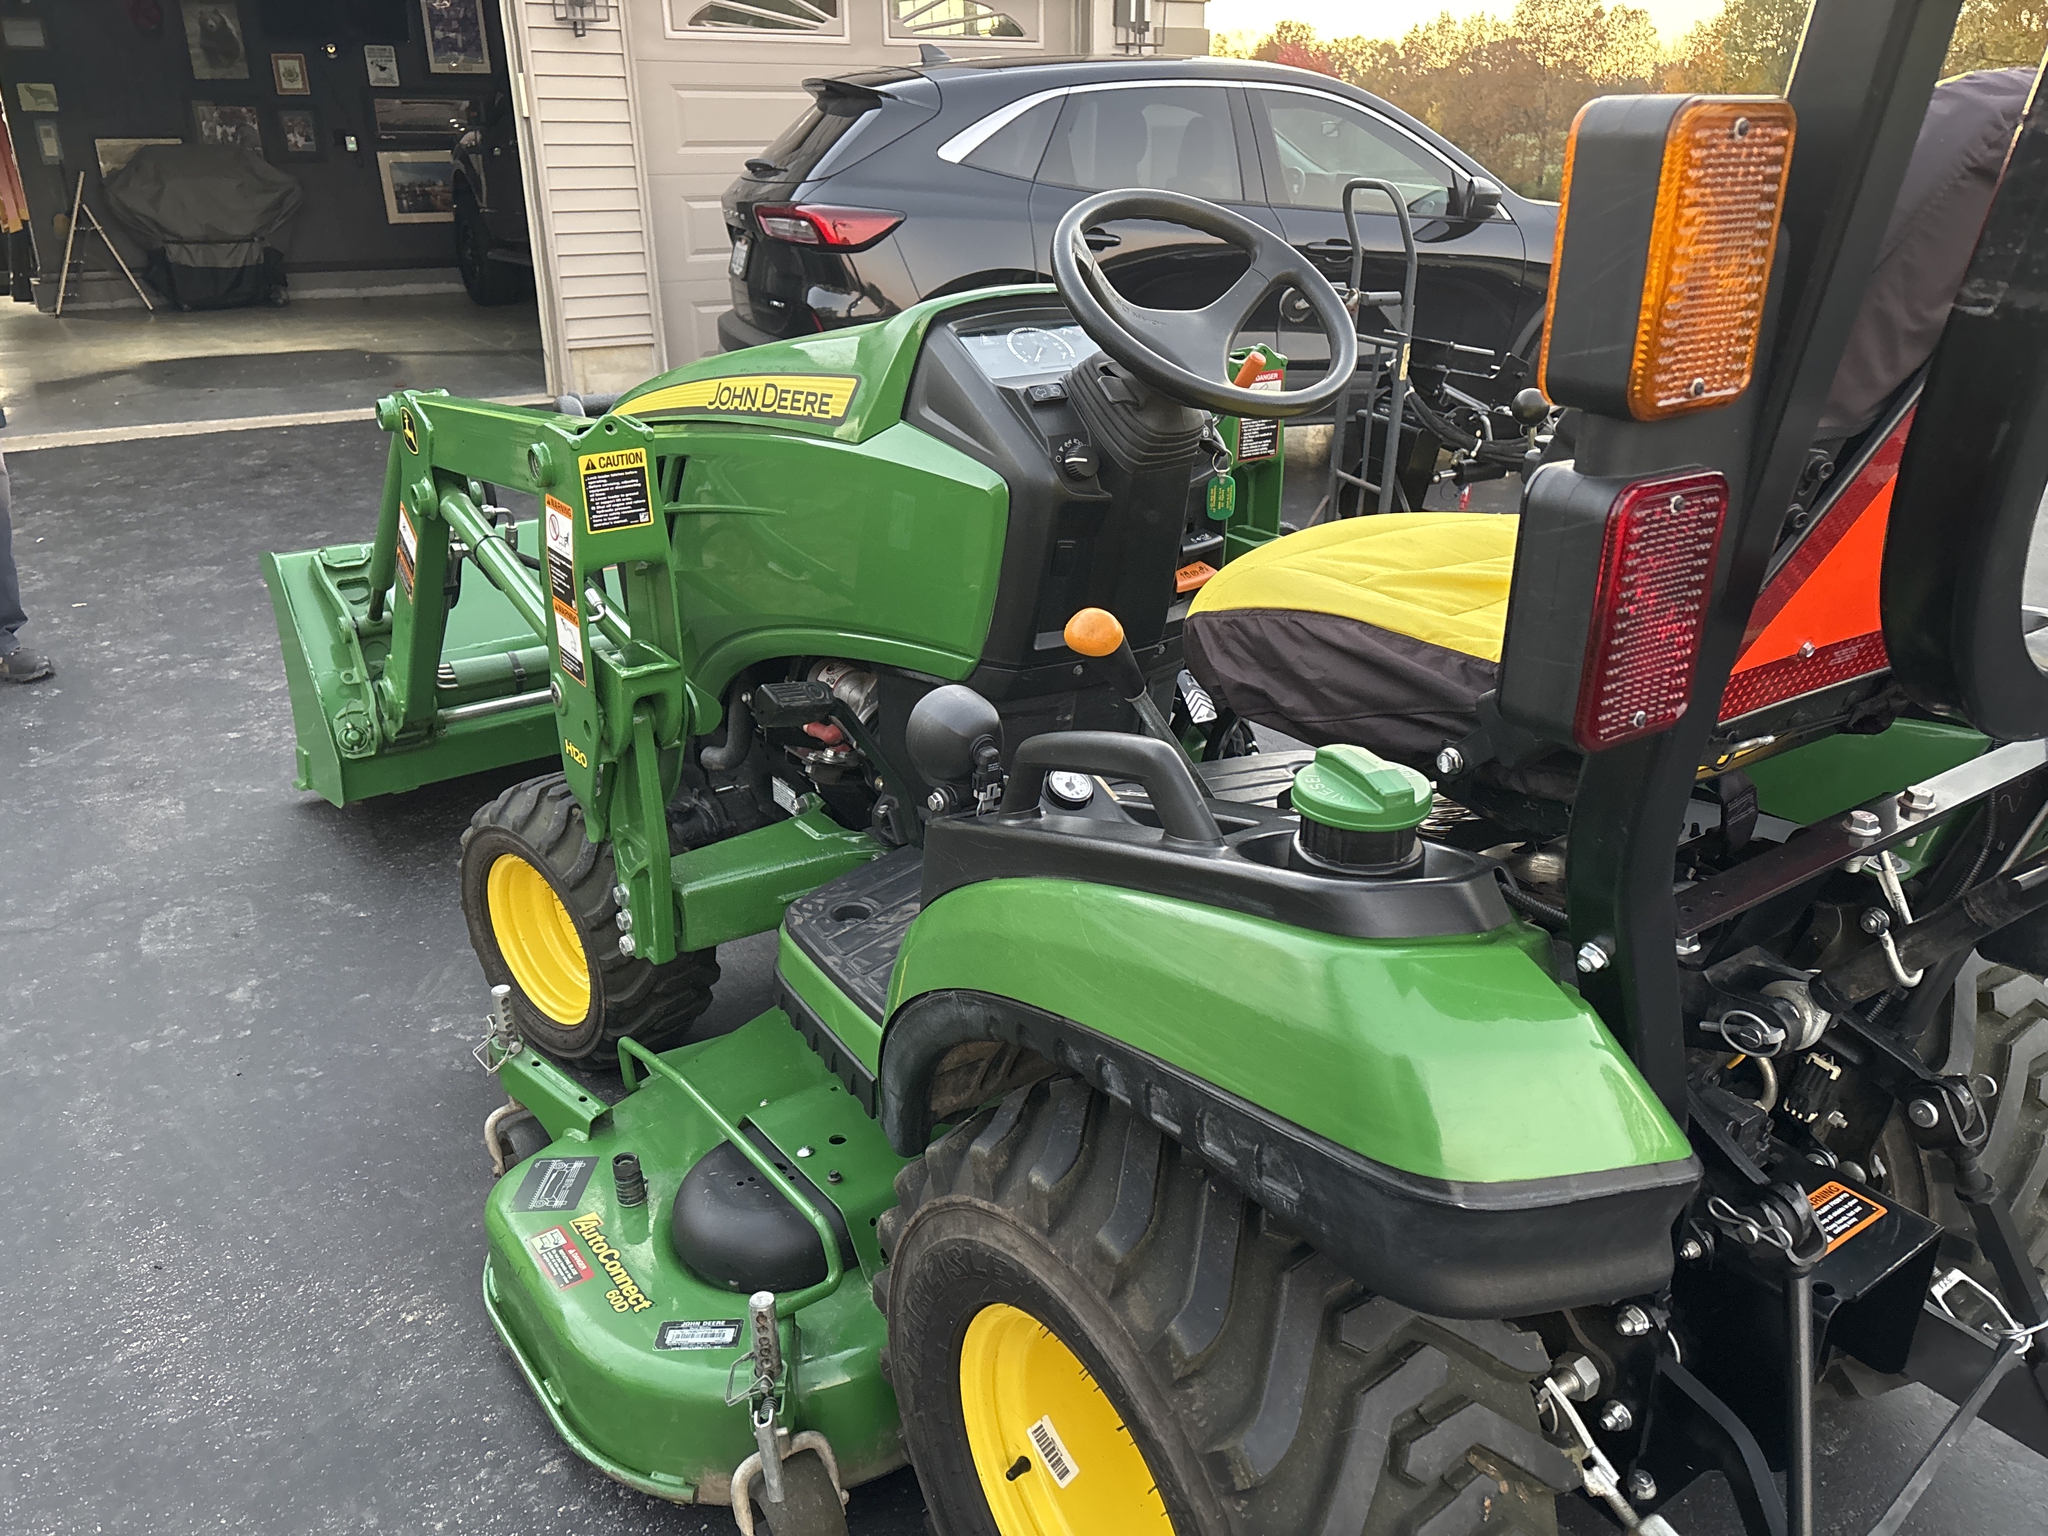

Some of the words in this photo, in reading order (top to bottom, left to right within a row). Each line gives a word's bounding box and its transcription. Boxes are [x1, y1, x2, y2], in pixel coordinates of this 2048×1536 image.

[1255, 373, 1278, 381] DANGER
[708, 382, 759, 408] JOHN
[761, 383, 834, 415] DEERE
[598, 452, 643, 469] CAUTION
[551, 498, 572, 518] WARNING
[564, 738, 588, 769] H120
[572, 1217, 653, 1313] AutoConnect
[605, 1289, 630, 1312] 60D
